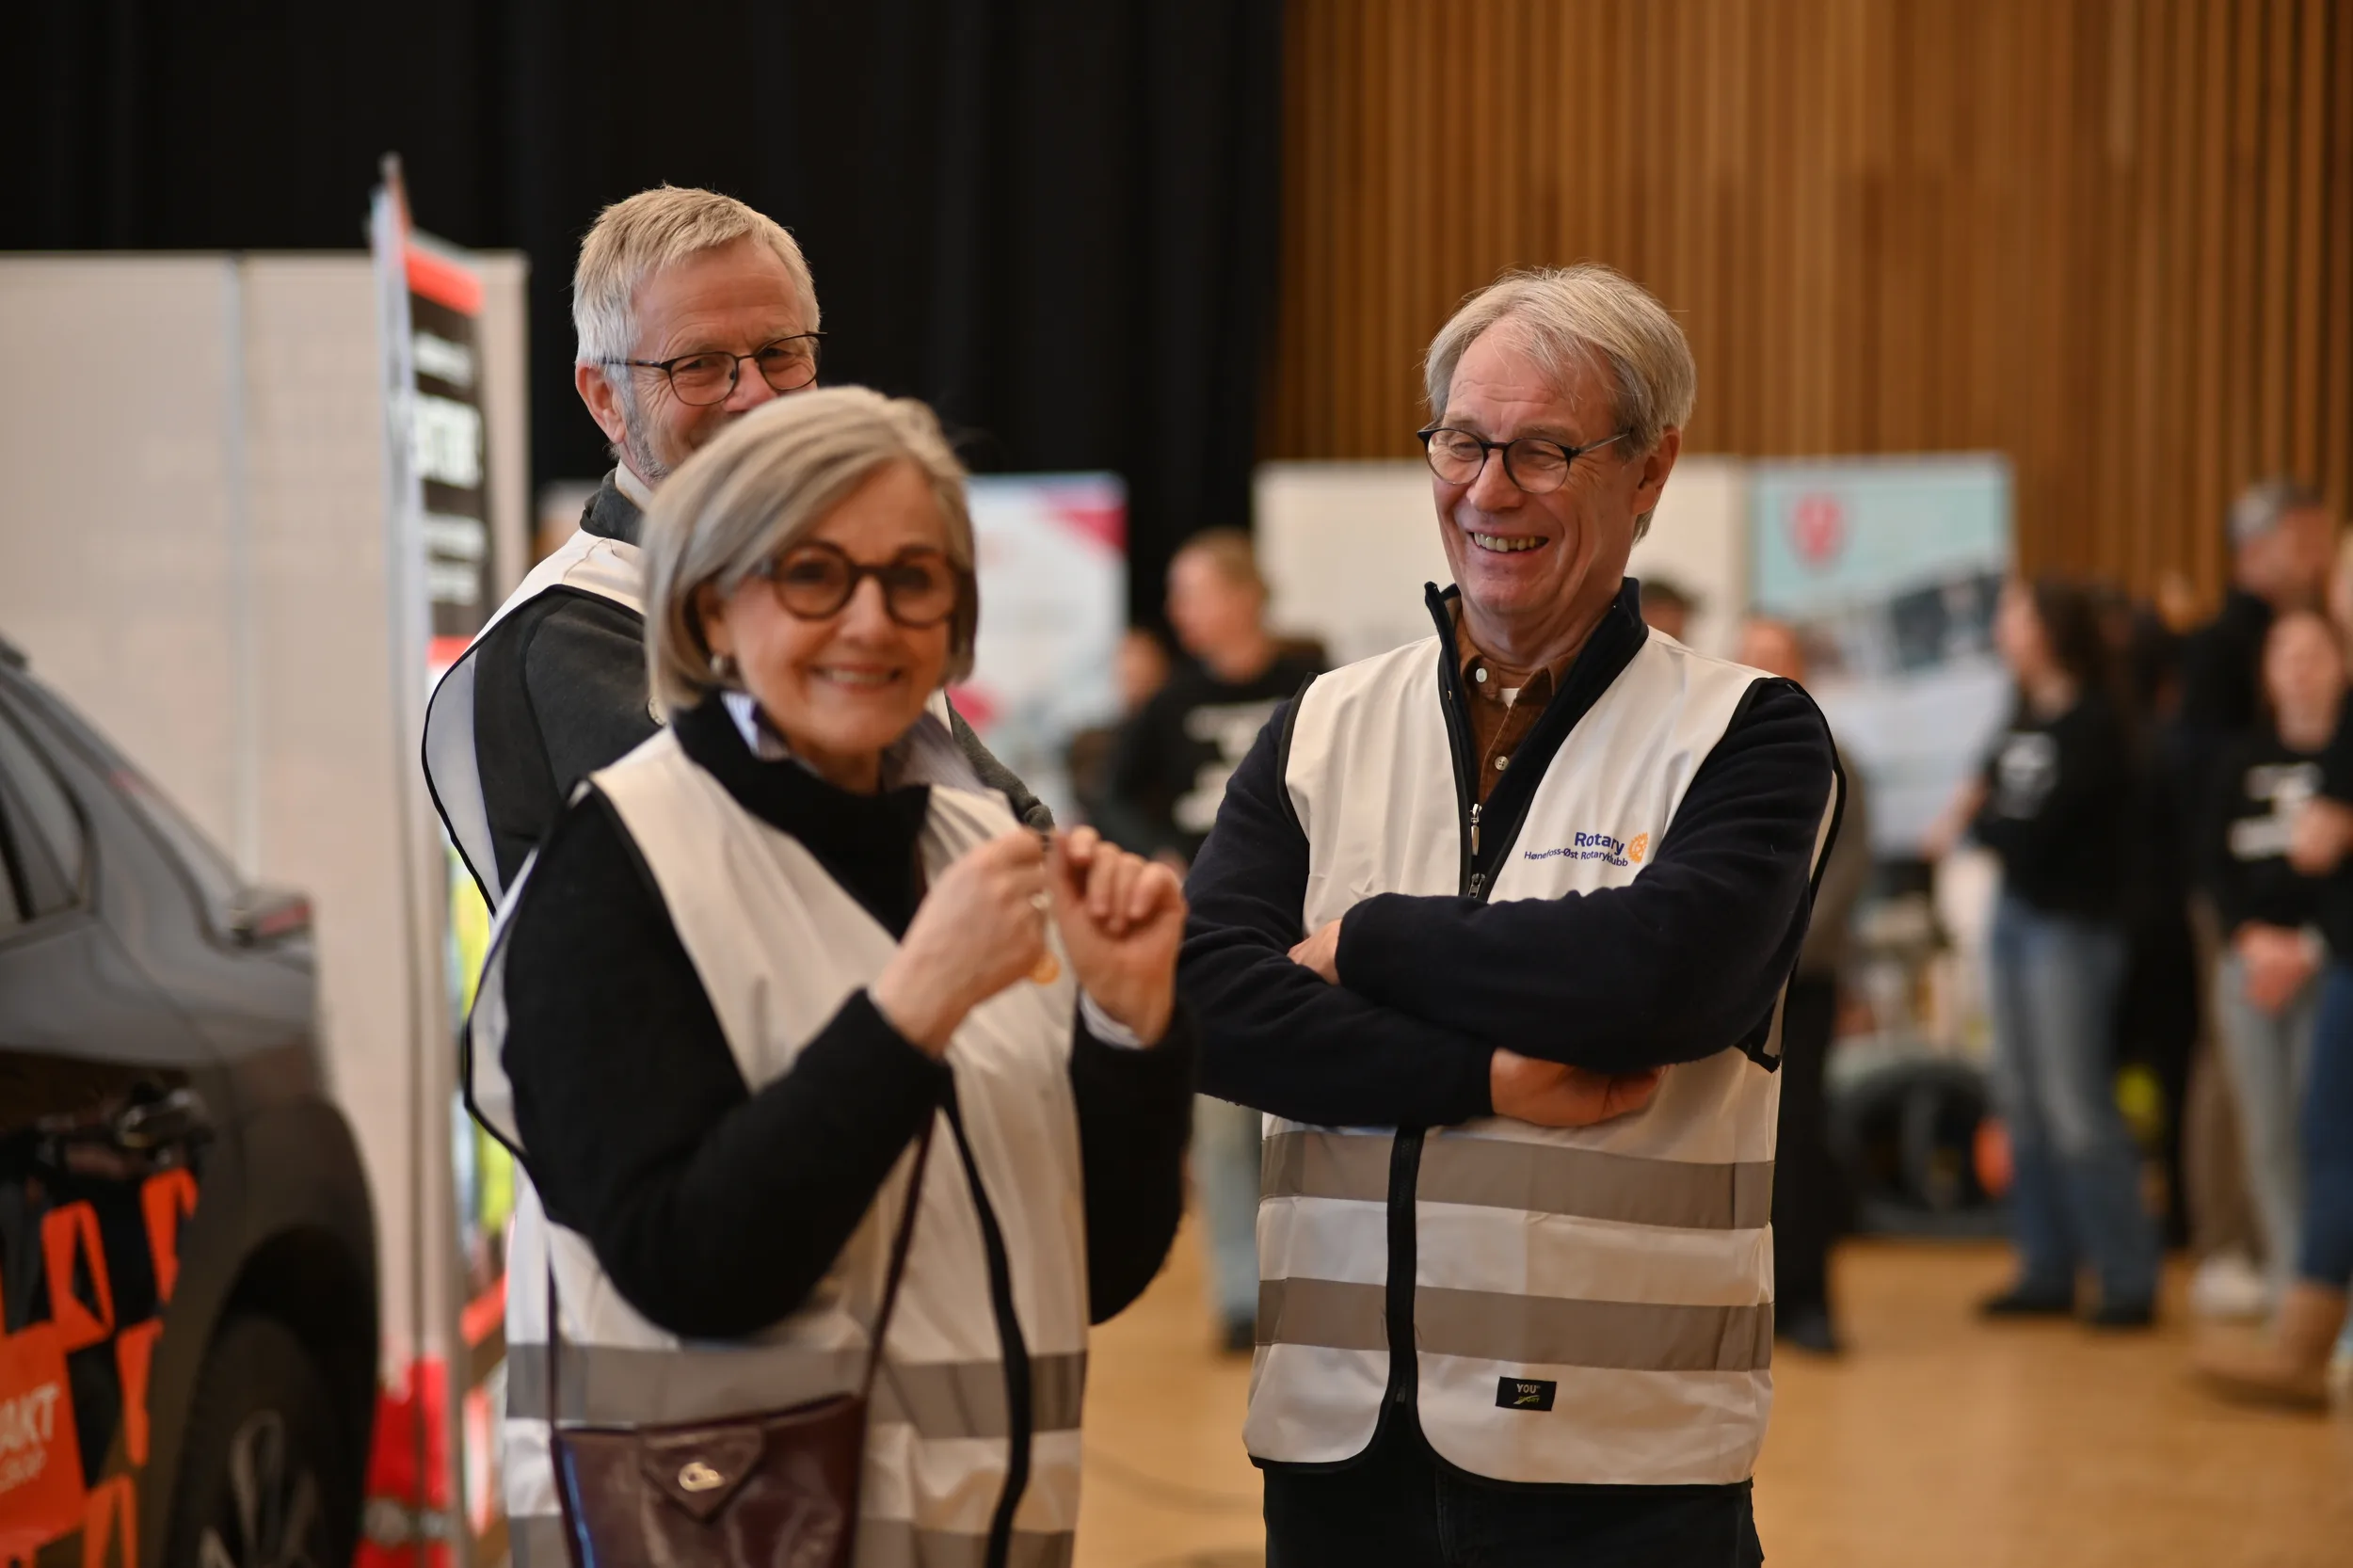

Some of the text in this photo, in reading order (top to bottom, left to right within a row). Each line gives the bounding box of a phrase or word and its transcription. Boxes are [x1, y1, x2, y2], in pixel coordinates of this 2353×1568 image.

[1574, 831, 1625, 856] Rotary
[1524, 847, 1628, 867] Hønefoss-Øst Rotaryklubb
[1516, 1384, 1537, 1393] YOU
